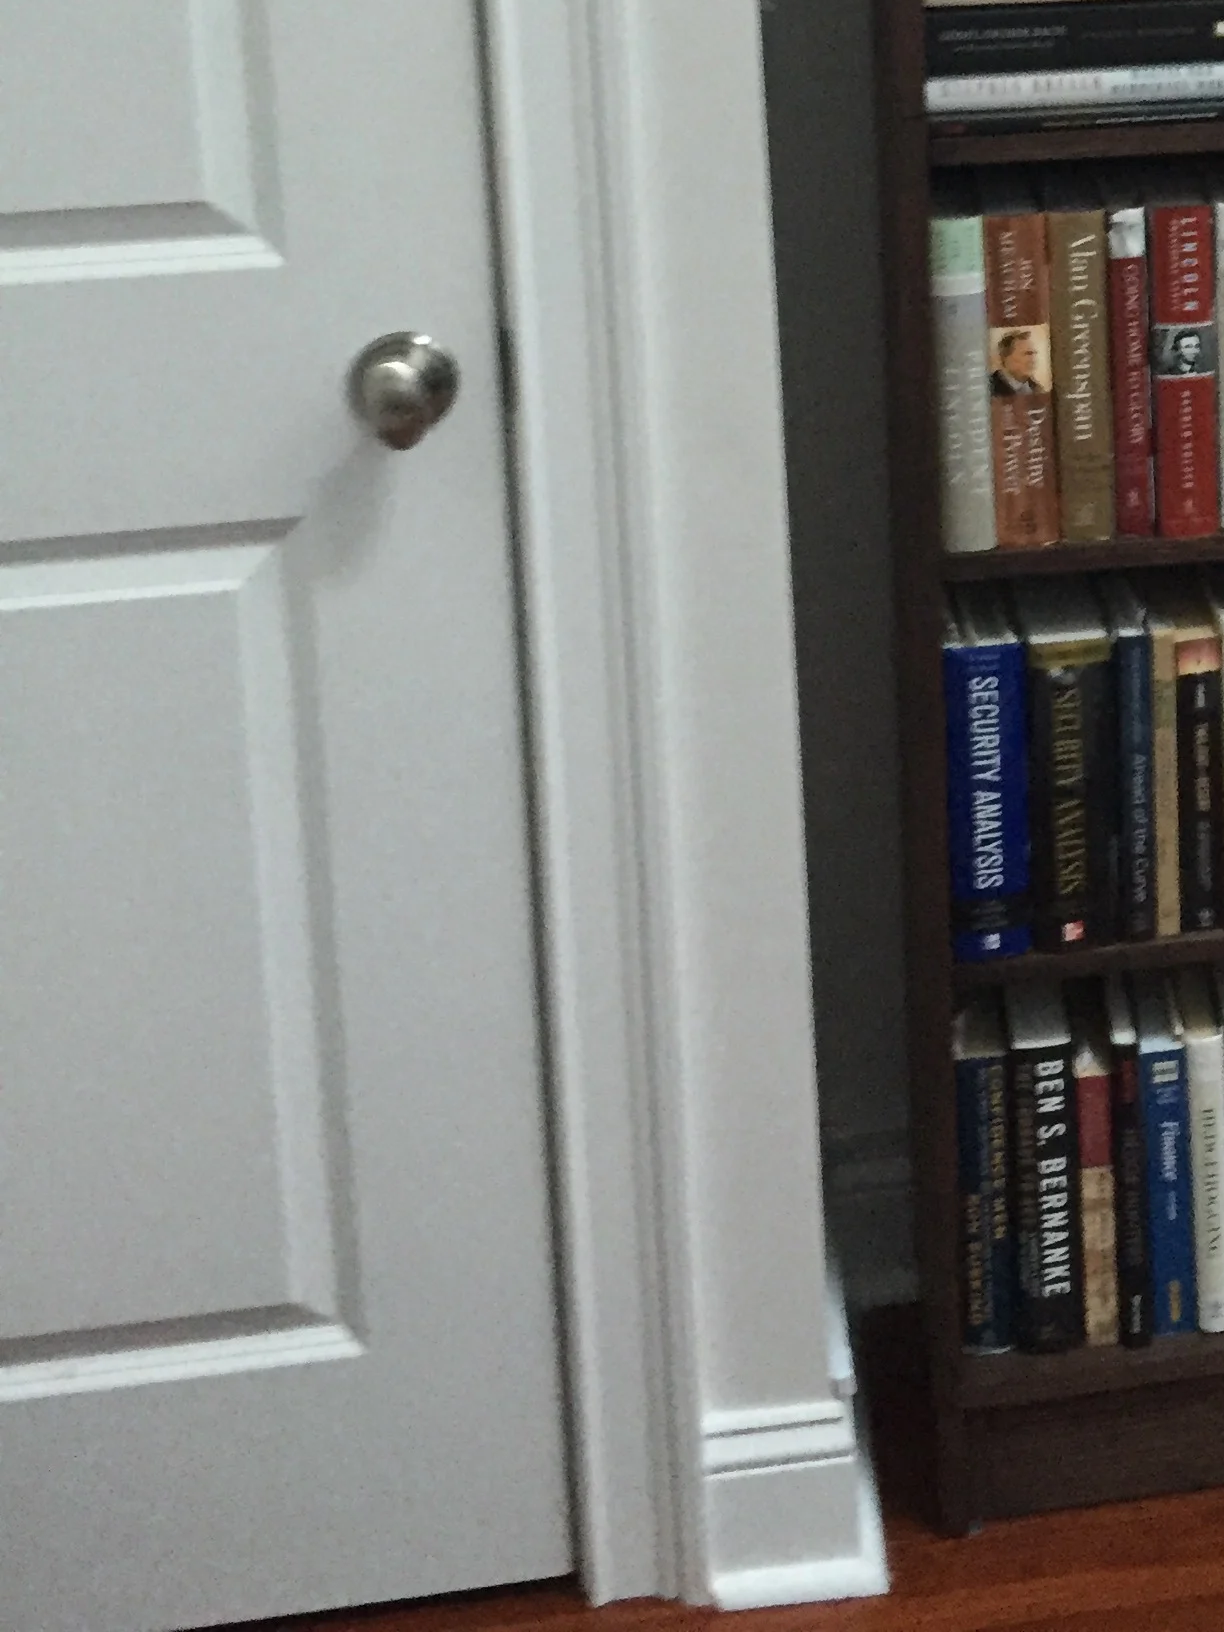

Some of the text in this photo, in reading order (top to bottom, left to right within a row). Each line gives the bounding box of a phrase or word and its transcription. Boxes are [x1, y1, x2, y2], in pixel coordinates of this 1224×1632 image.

[1066, 232, 1097, 442] Alan Greenspan
[1180, 216, 1199, 312] LINCOLN
[1003, 433, 1022, 495] Power
[1025, 407, 1047, 487] Destiny
[968, 676, 1004, 890] SECURITY ANALYSIS
[1052, 687, 1086, 895] SECURITY ANALYSIS
[1133, 858, 1149, 903] Curve
[1034, 1059, 1072, 1298] BEN S. BERNANKE
